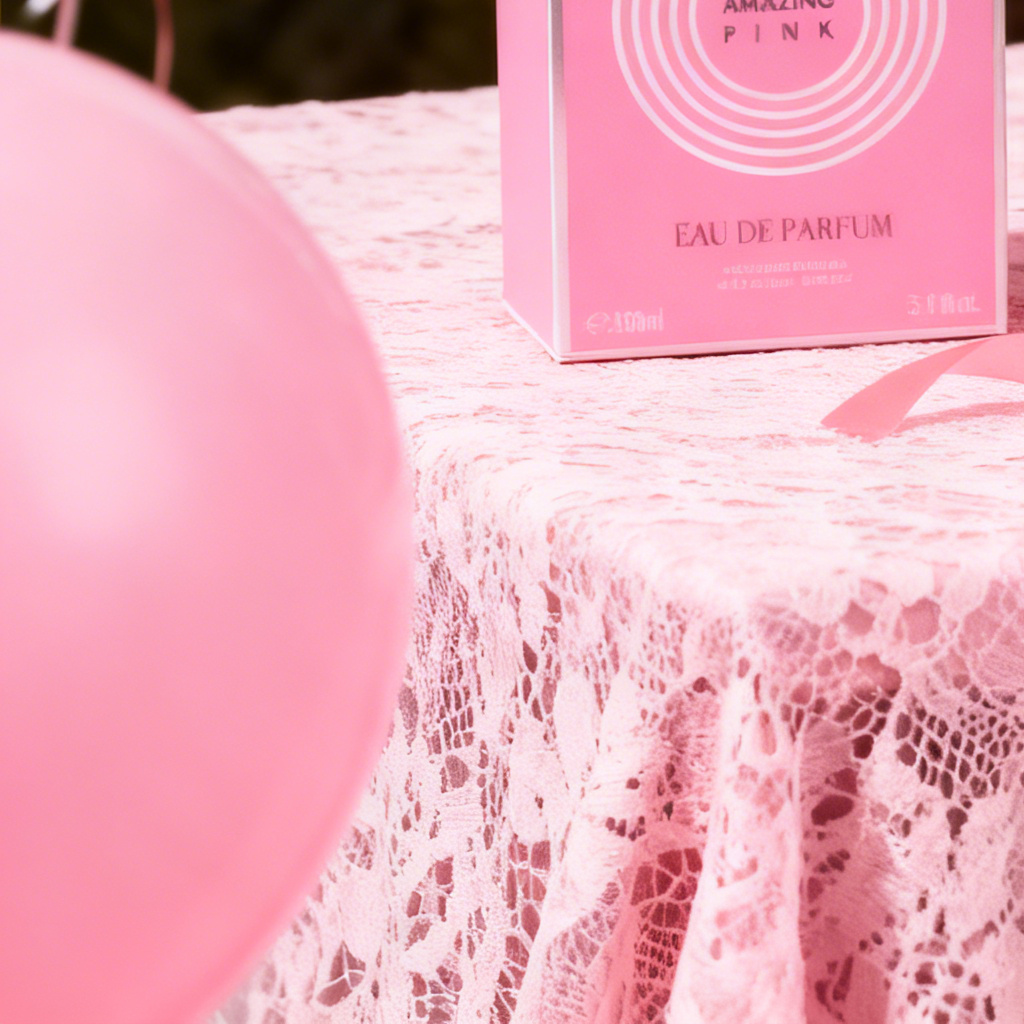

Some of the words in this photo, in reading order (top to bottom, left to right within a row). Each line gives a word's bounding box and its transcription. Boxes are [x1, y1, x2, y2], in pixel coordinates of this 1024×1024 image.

[723, 20, 834, 43] PINK
[675, 221, 728, 247] EAU
[737, 218, 774, 244] DE
[781, 213, 893, 242] PARFUM
